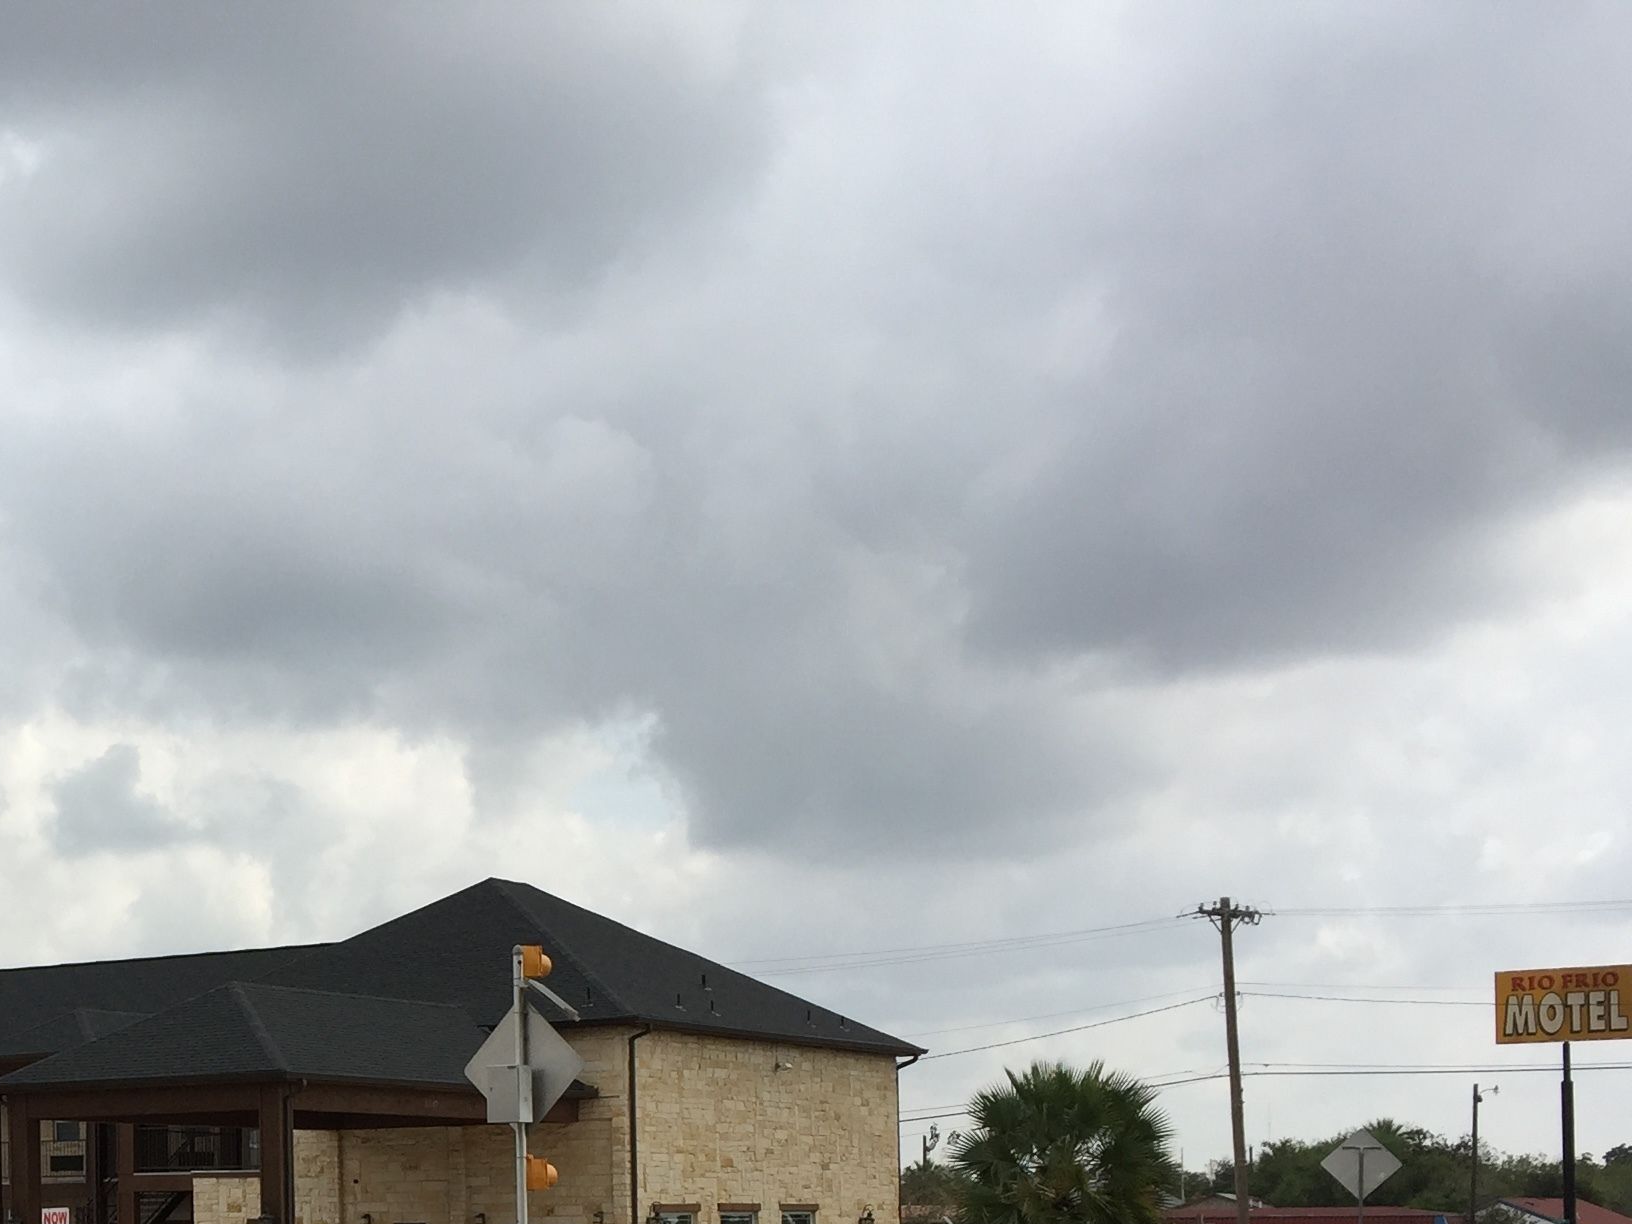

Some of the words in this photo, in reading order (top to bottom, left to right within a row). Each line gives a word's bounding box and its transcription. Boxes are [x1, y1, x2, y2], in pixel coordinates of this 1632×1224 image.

[1511, 975, 1555, 991] RIO
[1561, 971, 1619, 989] FRIO
[1504, 990, 1628, 1036] MOTEL
[43, 1212, 67, 1224] NOW
